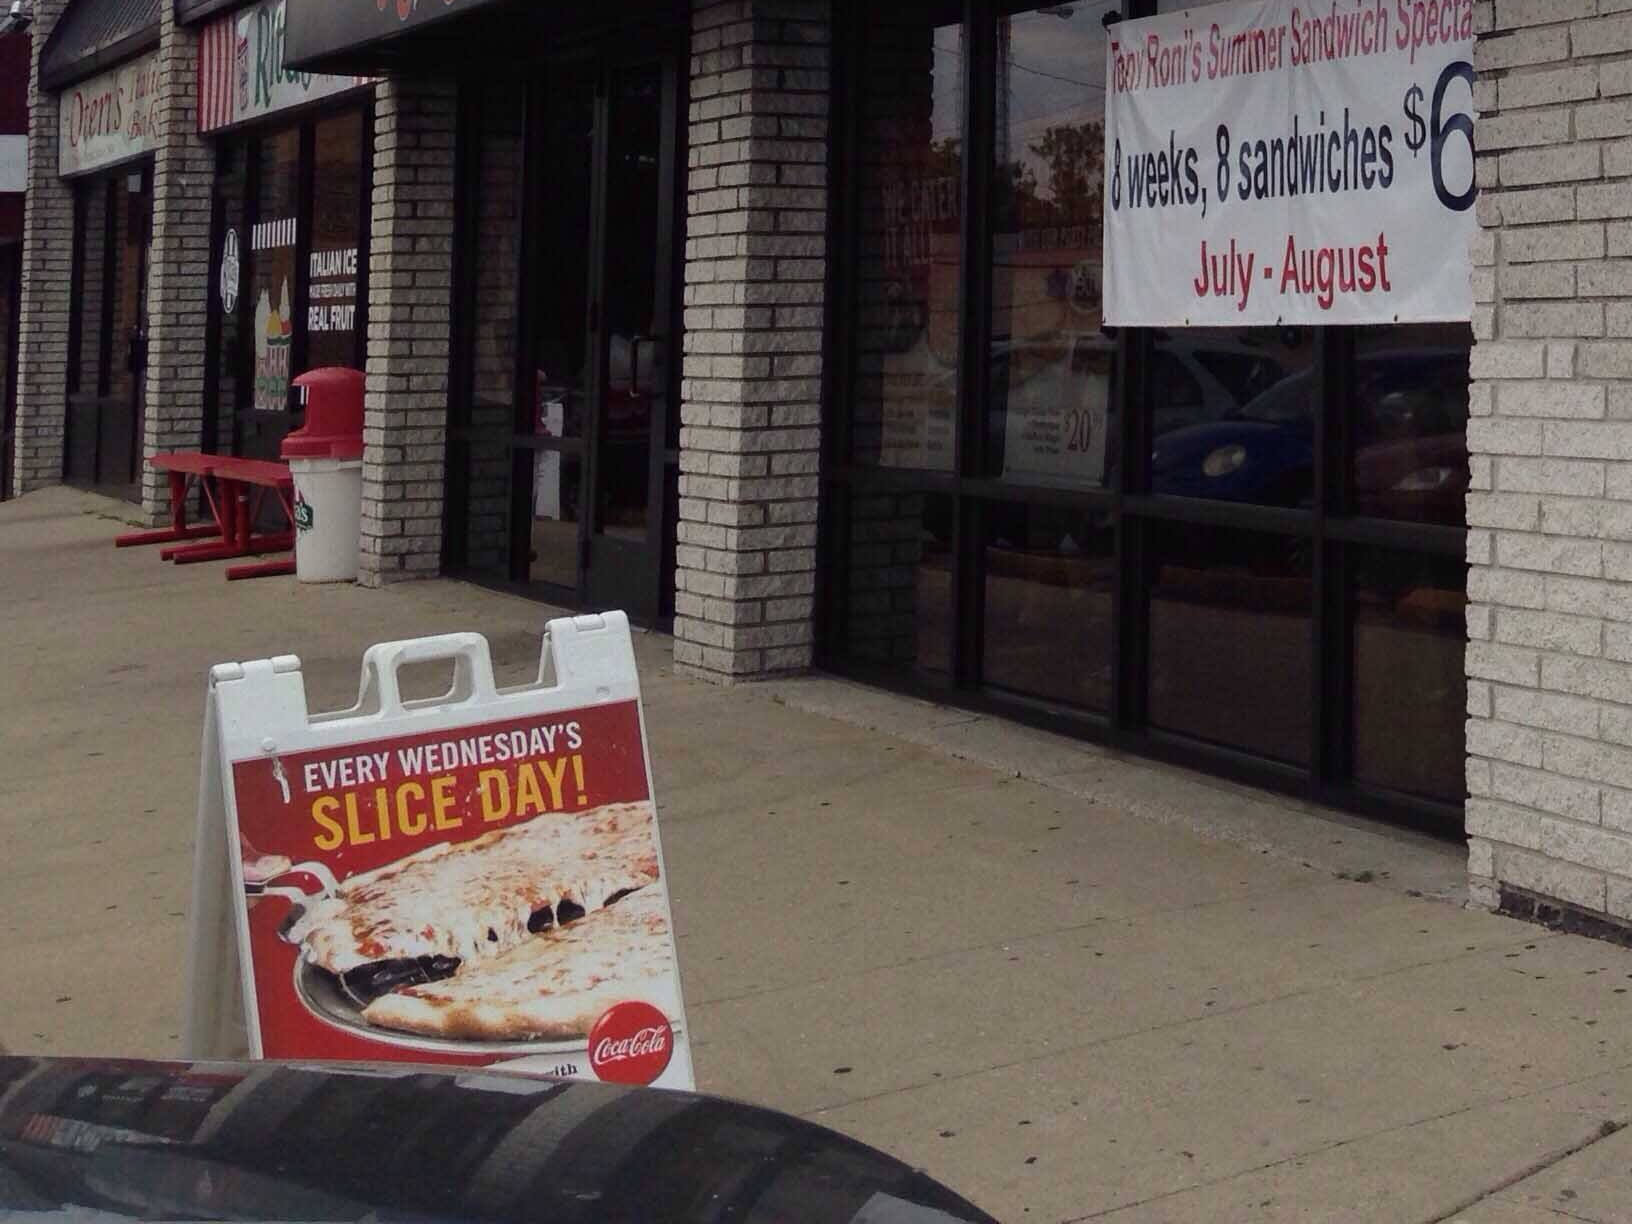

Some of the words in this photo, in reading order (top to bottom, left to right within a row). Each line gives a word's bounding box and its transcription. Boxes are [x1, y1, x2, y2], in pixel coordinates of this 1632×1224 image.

[1111, 40, 1144, 95] Tony
[1147, 28, 1202, 89] Roni's
[1207, 23, 1287, 81] Summer
[1111, 137, 1122, 211] 8
[1128, 129, 1208, 218] weeks,
[1215, 123, 1231, 203] 8
[1238, 107, 1394, 200] sandwiches
[309, 249, 342, 279] ITALIAN
[343, 247, 358, 275] ICE
[1193, 239, 1255, 312] July
[1279, 230, 1392, 310] August
[307, 305, 329, 332] REAL
[330, 304, 356, 331] FRUIT
[303, 750, 390, 794] EVERY
[398, 720, 584, 777] WEDNESDAY'S
[310, 772, 464, 853] SLICE
[480, 753, 589, 824] DAY!
[593, 1025, 668, 1066] Coca-Cola
